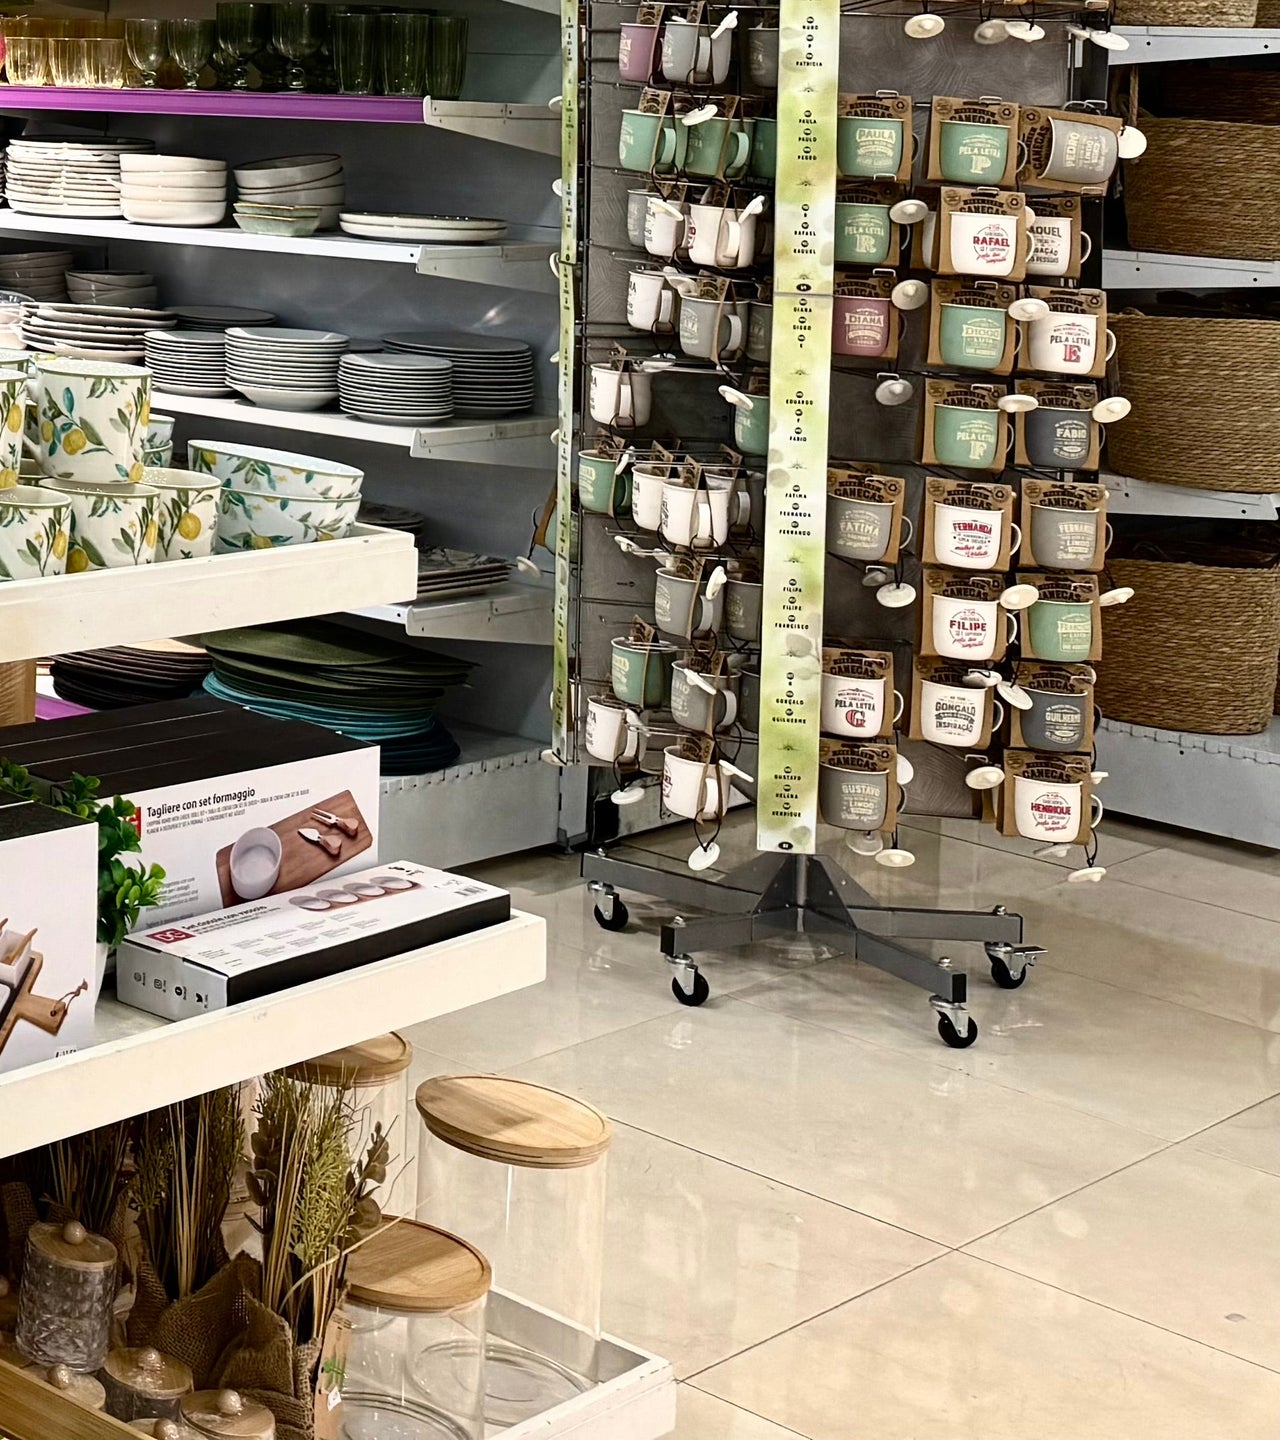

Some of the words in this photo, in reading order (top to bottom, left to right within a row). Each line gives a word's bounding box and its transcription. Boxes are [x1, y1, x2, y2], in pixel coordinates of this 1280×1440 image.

[855, 128, 896, 142] PAULA
[958, 145, 978, 156] PELA
[1065, 131, 1081, 168] PEDRO
[969, 155, 992, 175] P
[844, 225, 862, 236] PELA
[1028, 226, 1062, 238] AQUEL
[855, 233, 877, 254] R
[972, 235, 1011, 248] RAFAEL
[847, 313, 884, 325] DIANA
[1049, 334, 1068, 345] PELA
[1062, 343, 1082, 363] E
[956, 431, 973, 441] PELA
[968, 440, 988, 461] F
[834, 488, 885, 504] CANECAS
[943, 497, 993, 511] CANECAS
[952, 521, 993, 535] FERNANDA
[949, 619, 987, 632] FILIPE
[834, 699, 854, 710] PELA
[855, 700, 876, 712] LETRA
[935, 700, 977, 717] GONÇALO
[845, 709, 866, 728] G
[935, 719, 974, 734] INSPIRAÇÃO
[828, 756, 878, 771] CANECAS
[1022, 768, 1072, 783] CANECAS
[842, 783, 881, 797] GUSTAVO
[147, 802, 181, 819] Tagliere
[182, 799, 197, 809] con
[198, 796, 211, 808] set
[212, 787, 256, 804] formaggio
[1030, 801, 1072, 816] HENRIQUE
